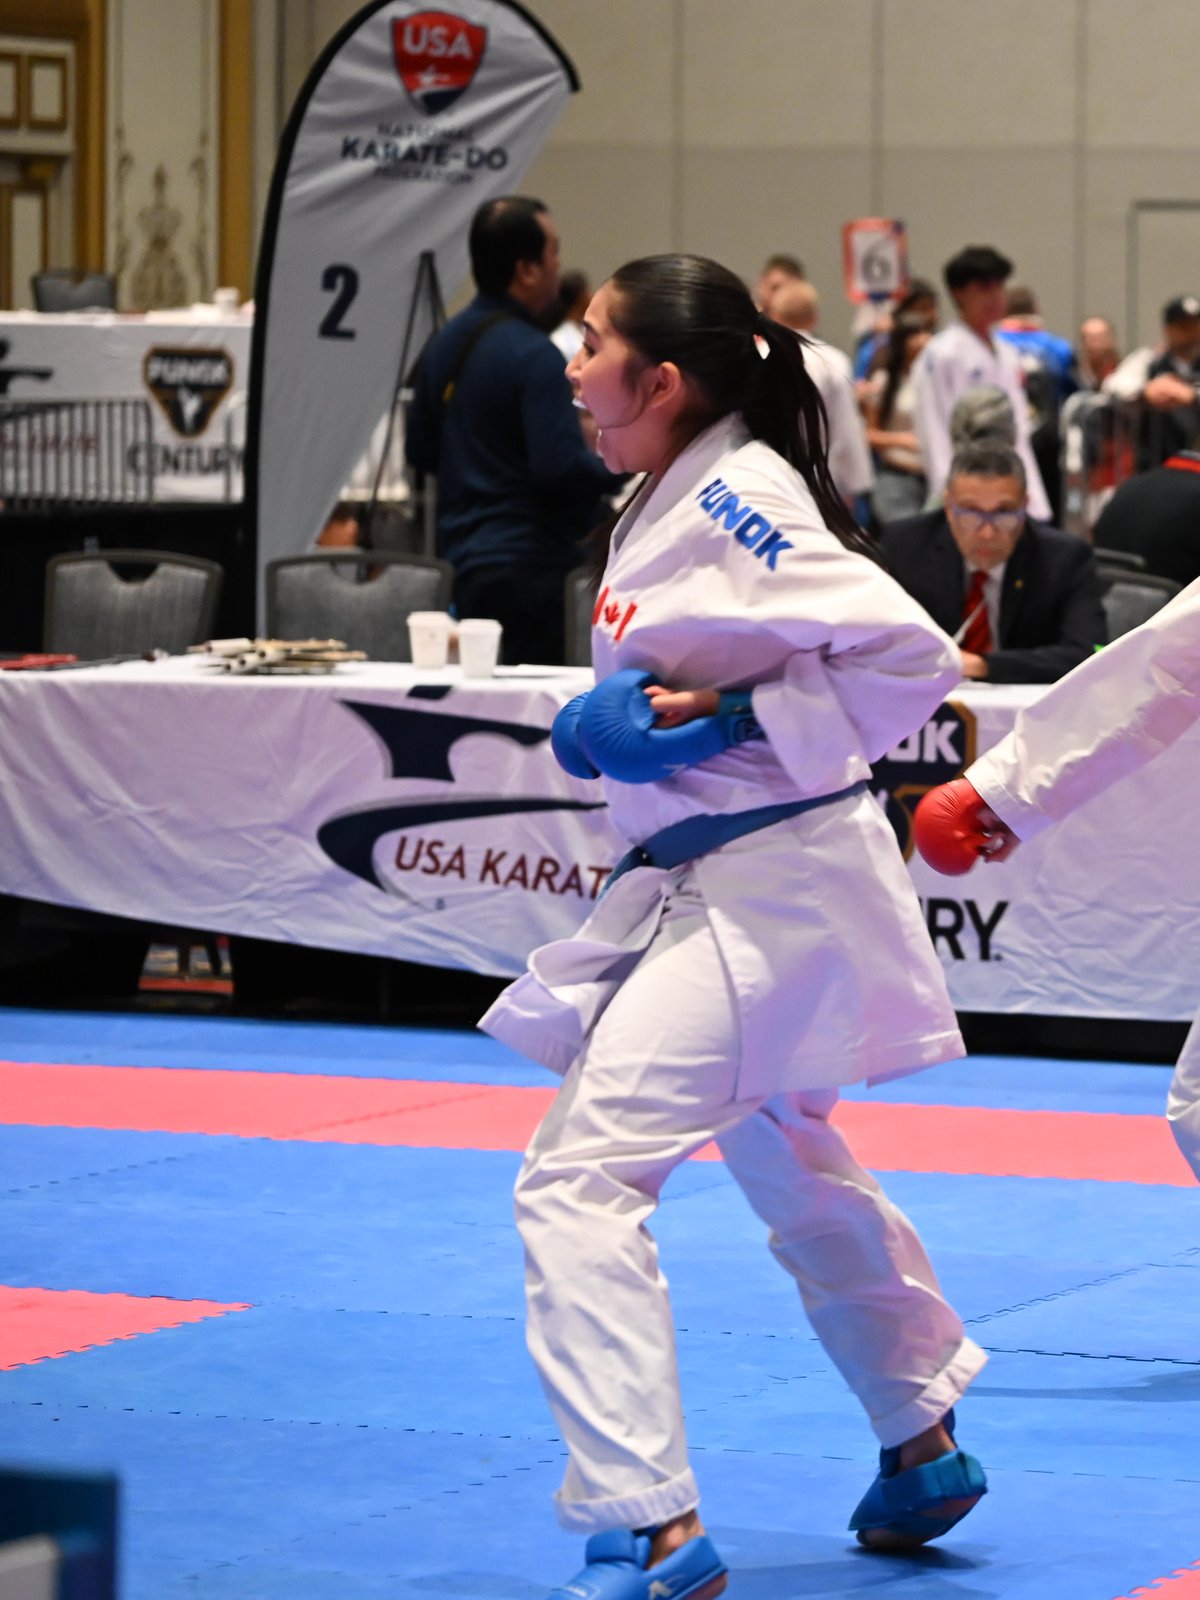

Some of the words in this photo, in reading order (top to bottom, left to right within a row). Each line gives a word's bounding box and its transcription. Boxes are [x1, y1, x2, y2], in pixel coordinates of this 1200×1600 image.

[403, 24, 473, 60] USA
[340, 136, 508, 171] KARATE-DO
[861, 240, 893, 289] 6
[318, 263, 361, 341] 2
[394, 835, 466, 881] USA
